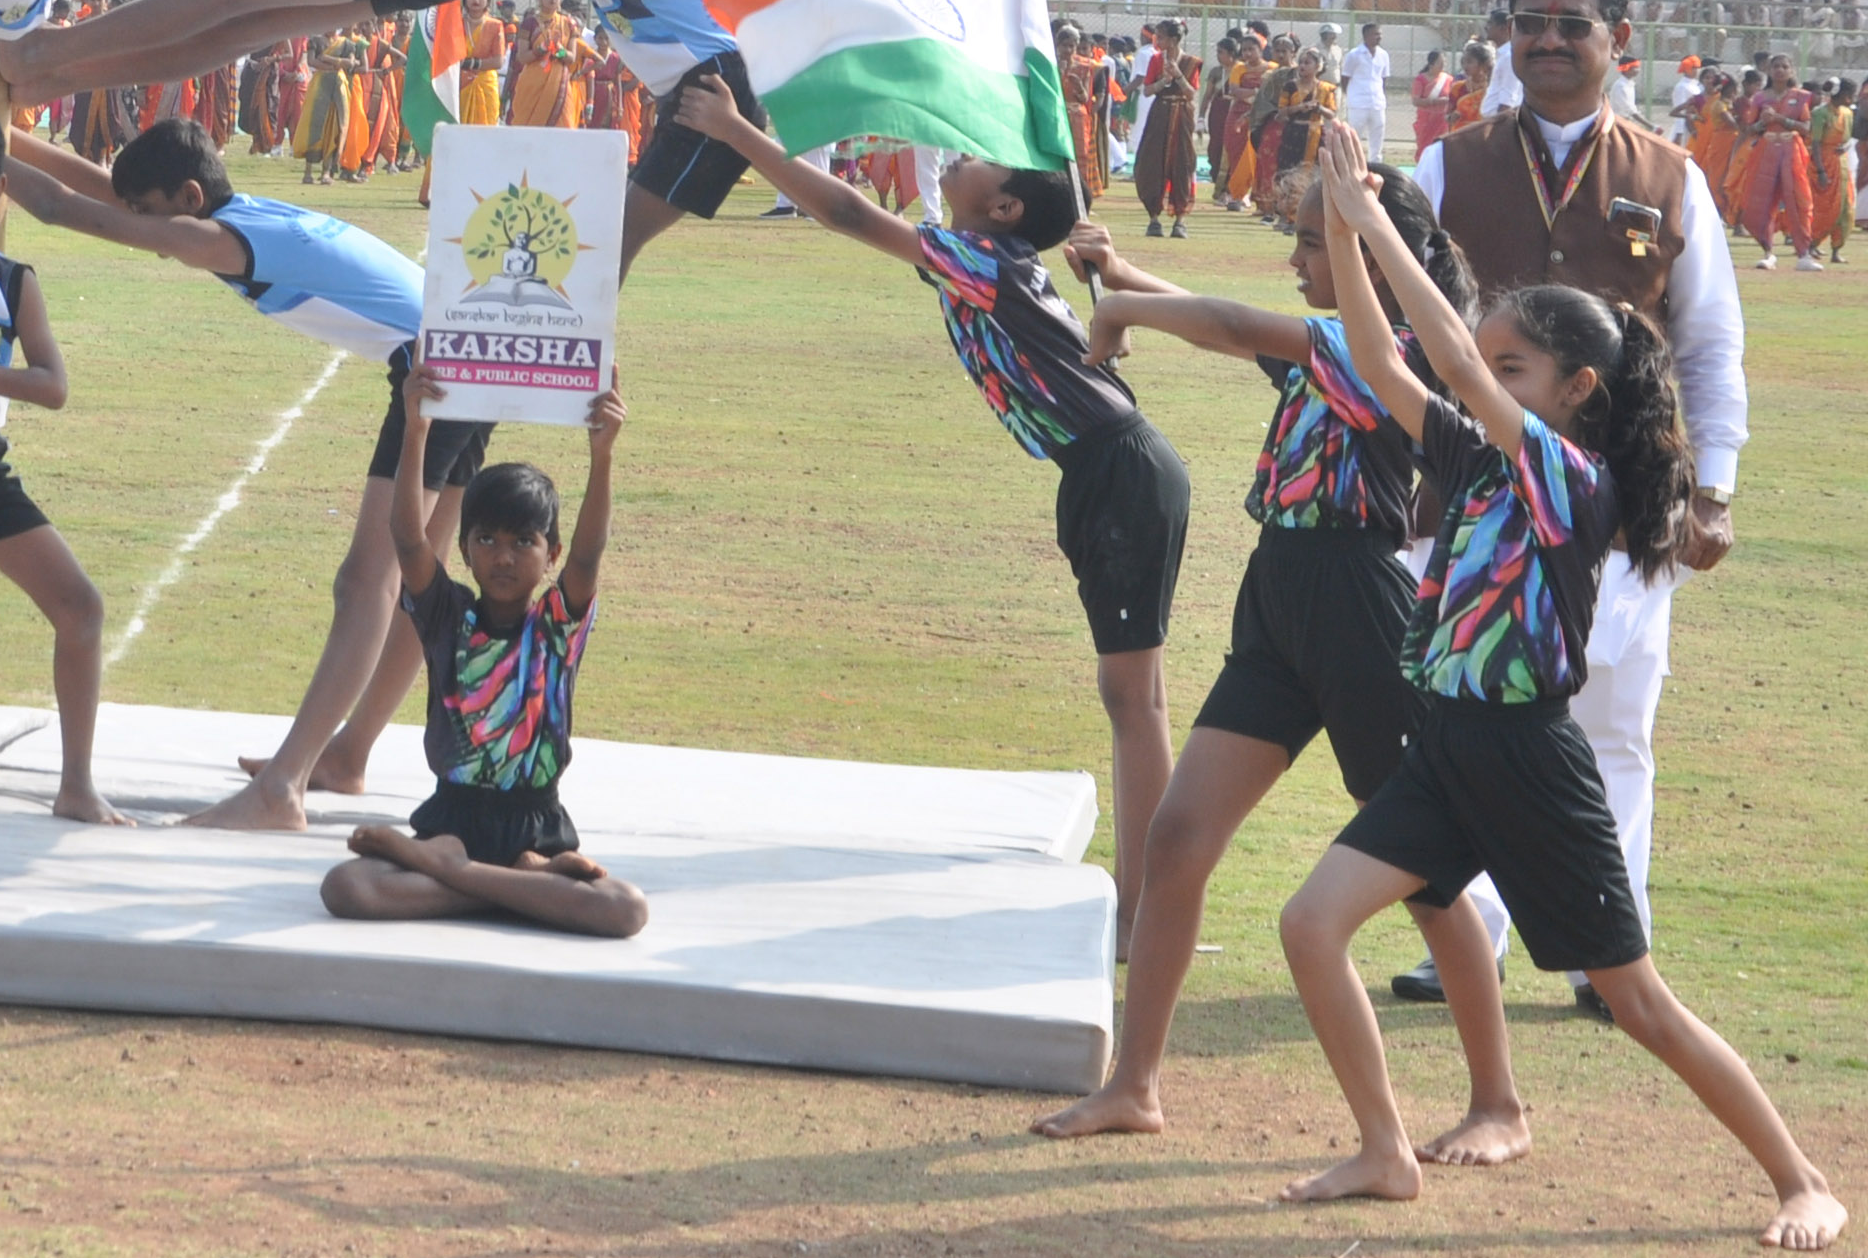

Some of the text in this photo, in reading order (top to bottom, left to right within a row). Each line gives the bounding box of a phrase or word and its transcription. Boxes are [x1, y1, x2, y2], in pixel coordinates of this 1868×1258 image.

[428, 331, 595, 368] KAKSHA
[432, 366, 594, 388] RE & PUBLIC SCHOOL
